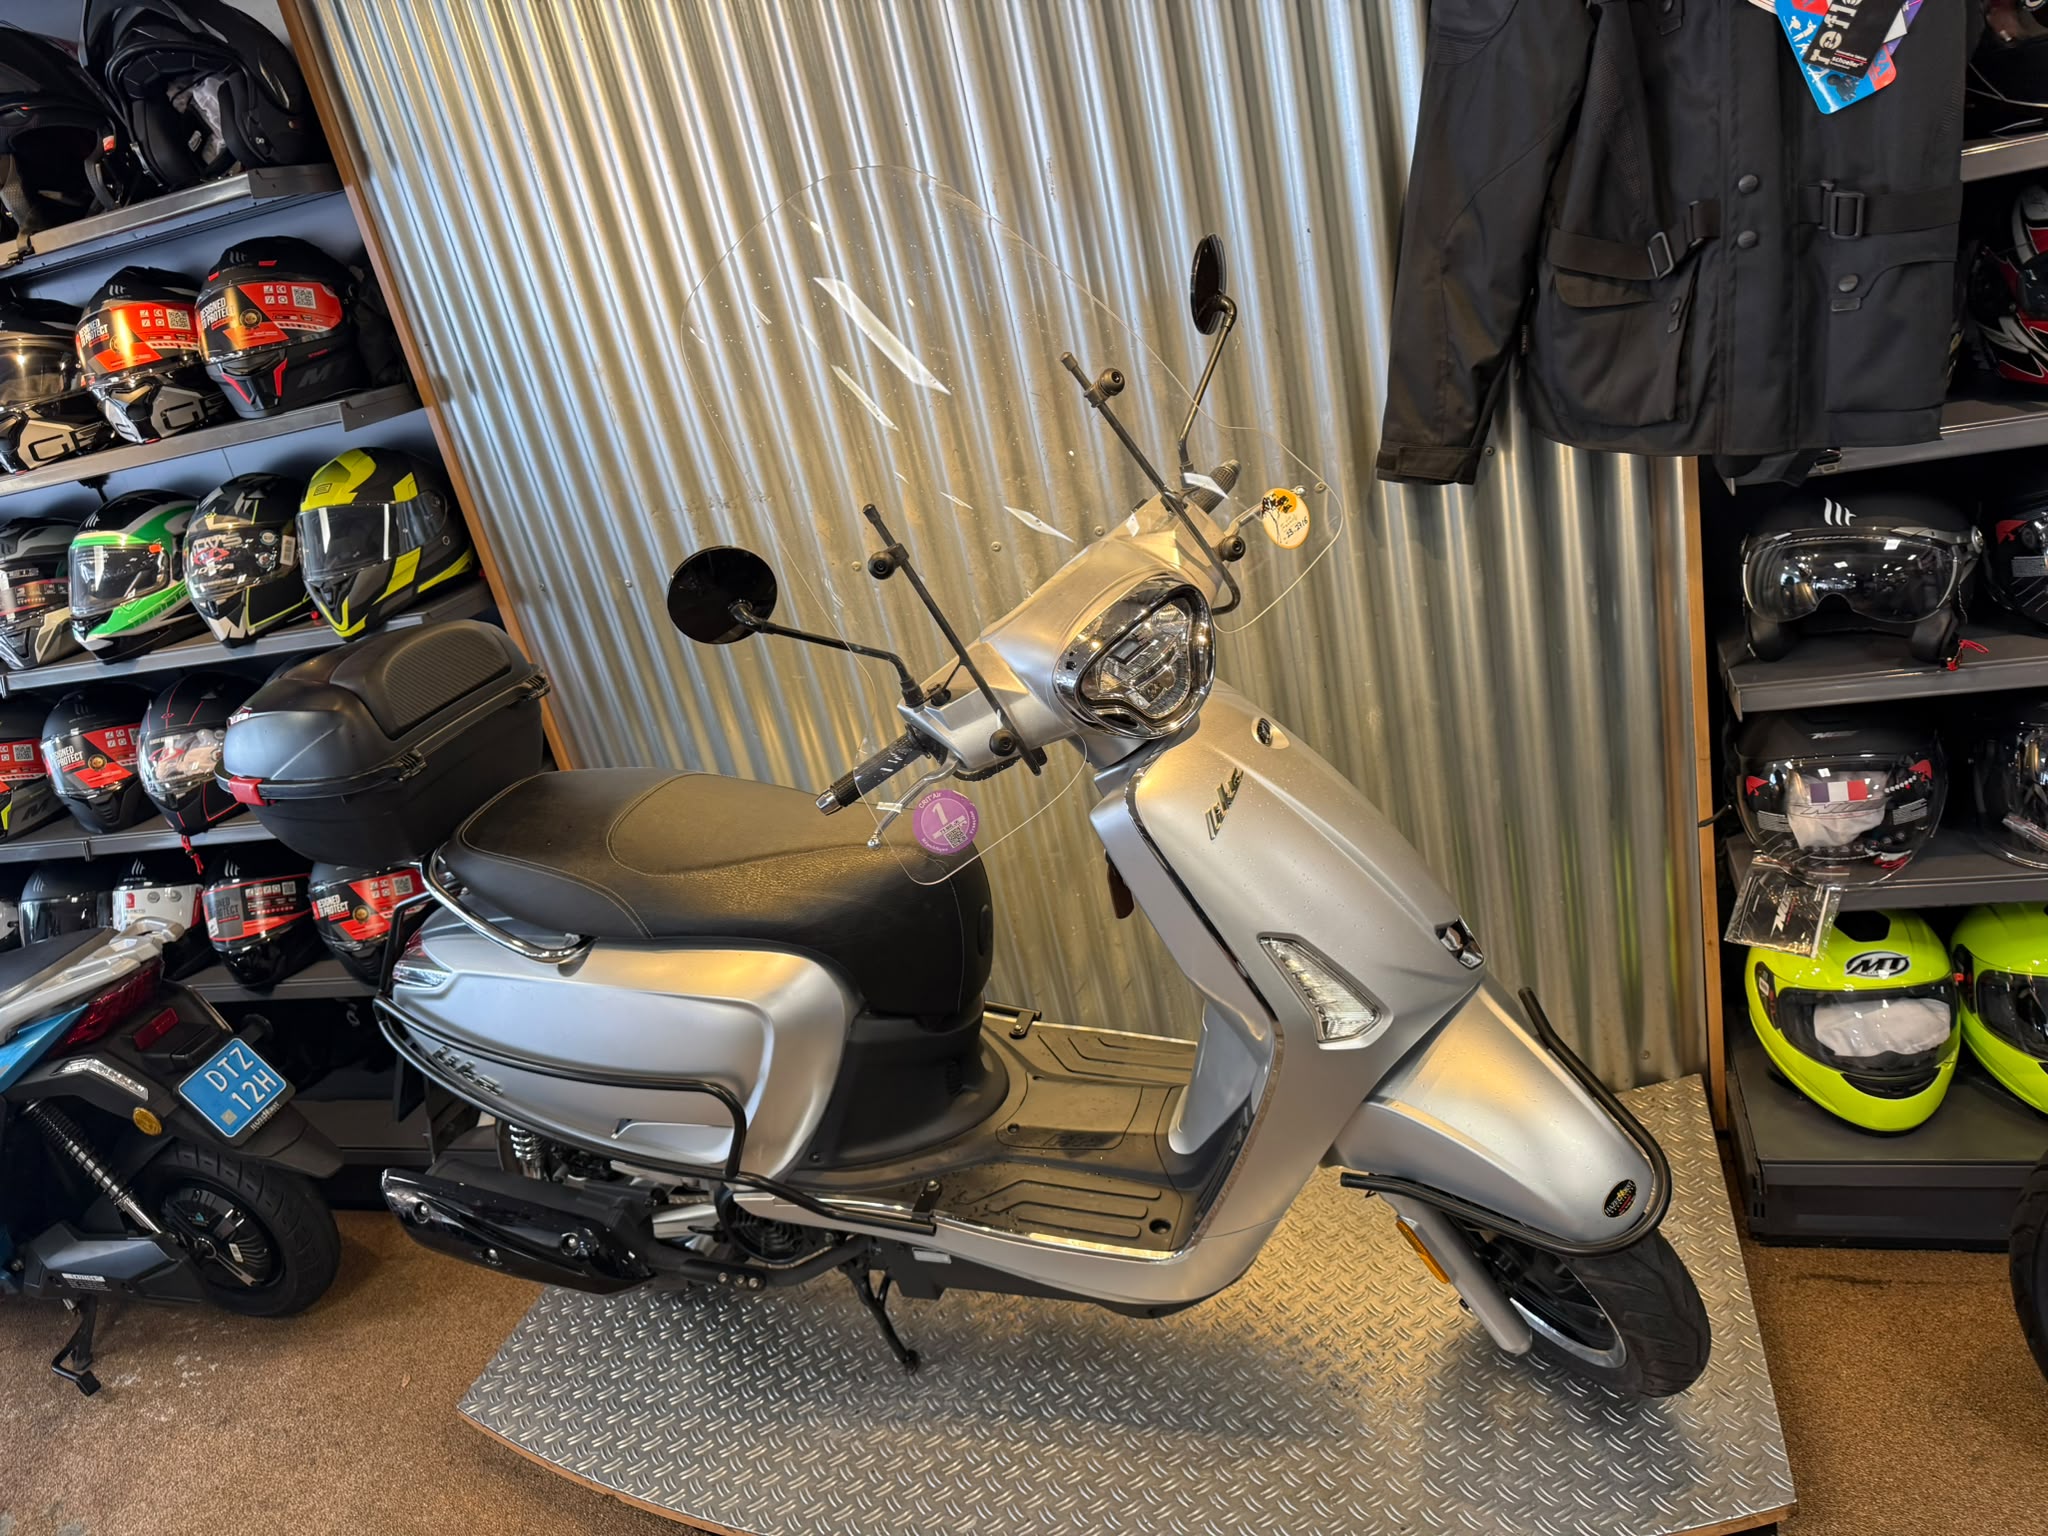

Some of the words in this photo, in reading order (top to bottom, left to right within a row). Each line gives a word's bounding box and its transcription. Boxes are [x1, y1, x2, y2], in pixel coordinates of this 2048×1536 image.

[933, 802, 948, 825] 1
[1846, 955, 1909, 974] MT
[205, 1047, 254, 1092] DTZ
[232, 1069, 278, 1111] 12H
